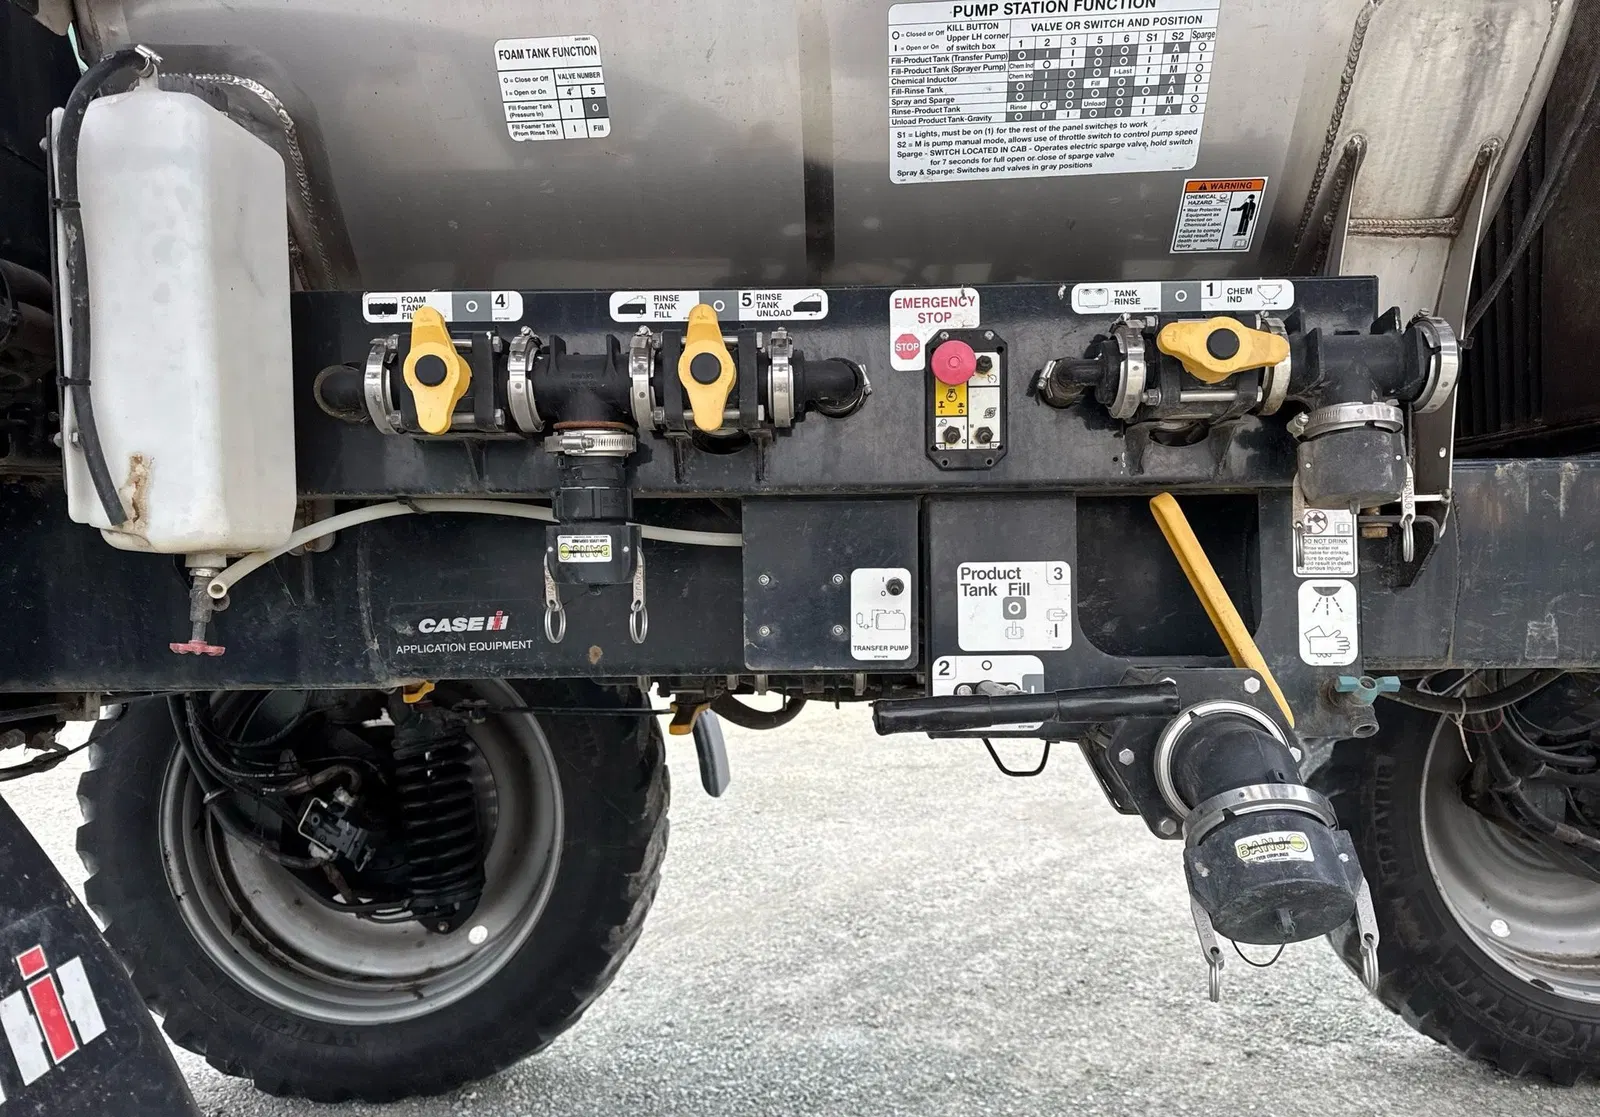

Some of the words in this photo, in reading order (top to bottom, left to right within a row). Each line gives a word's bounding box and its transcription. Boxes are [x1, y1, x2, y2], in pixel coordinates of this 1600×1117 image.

[953, 4, 998, 17] PUMP
[1004, 1, 1068, 15] STATION
[1074, 0, 1155, 12] FUNCTION
[1031, 22, 1062, 32] VALVE
[1066, 22, 1080, 30] OR
[1084, 19, 1124, 29] SWITCH
[1127, 18, 1149, 27] AND
[1153, 15, 1203, 26] POSITION
[947, 34, 969, 42] Upper
[1019, 40, 1023, 48] 1
[1071, 37, 1076, 45] 3
[1097, 36, 1103, 44] 5
[1146, 33, 1158, 42] S1
[1172, 32, 1184, 40] S2
[1192, 30, 1215, 39] Sparge
[499, 49, 524, 60] FOAM
[526, 48, 550, 58] TANK
[552, 46, 597, 57] FUNCTION
[891, 56, 932, 64] Fill-Product
[985, 53, 1008, 61] Pump)
[891, 67, 932, 75] Fill-Product
[951, 65, 981, 73] (Sprayer
[591, 87, 595, 95] 5
[929, 96, 955, 104] Sparge
[918, 116, 946, 124] Product
[948, 115, 992, 123] Tank-Gravity
[897, 151, 922, 159] Sparge
[962, 147, 998, 155] LOCATED
[1034, 144, 1068, 152] Operates
[1059, 162, 1092, 170] positions
[1206, 282, 1213, 296] 1
[495, 294, 505, 307] 4
[742, 293, 751, 306] 5
[895, 296, 975, 308] EMERGENCY
[918, 312, 952, 324] STOP
[896, 343, 919, 351] STOP
[559, 542, 610, 560] BANJO
[961, 567, 1021, 580] Product
[1054, 568, 1063, 580] 3
[961, 583, 997, 596] Tank
[1009, 582, 1030, 596] Fill
[418, 617, 484, 633] CASE
[396, 643, 465, 654] APPLICATION
[470, 640, 533, 651] EQUIPMENT
[939, 661, 950, 675] 2
[1238, 834, 1308, 858] BANJO
